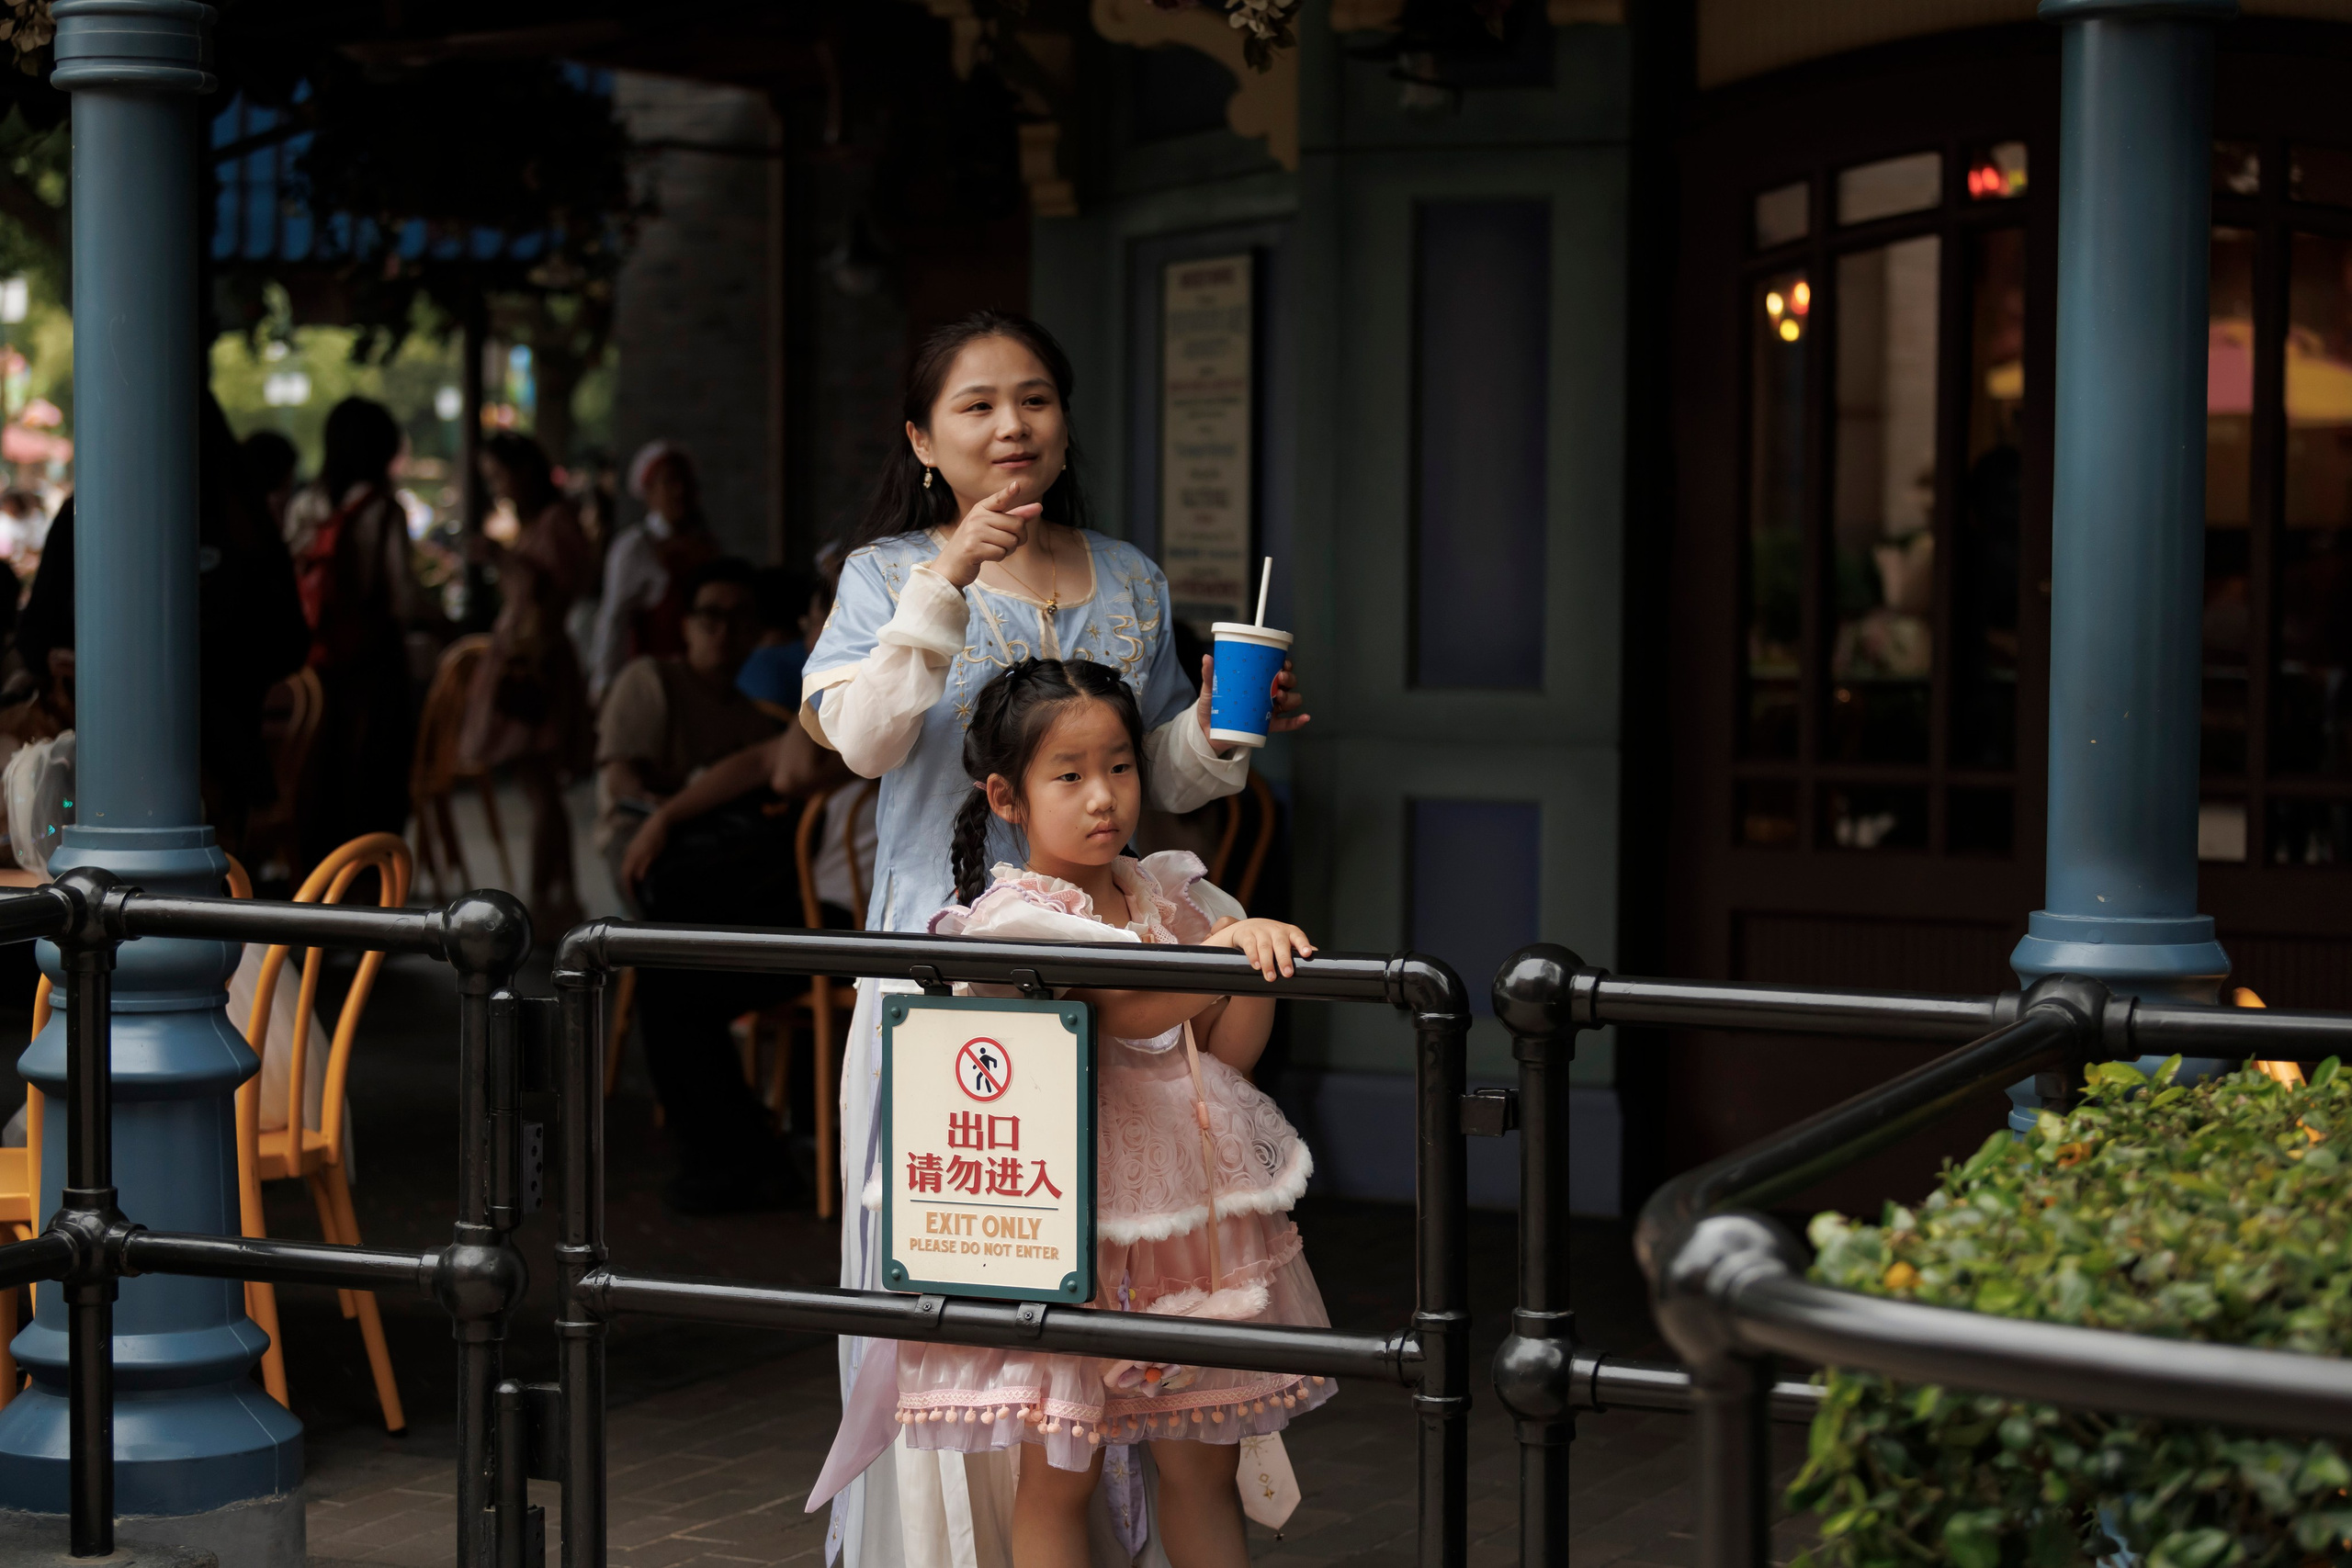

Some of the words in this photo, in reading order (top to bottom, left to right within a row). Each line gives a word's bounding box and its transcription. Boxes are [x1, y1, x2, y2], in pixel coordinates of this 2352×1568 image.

[947, 1110, 1021, 1151] 出口
[906, 1151, 1063, 1200] 请勿进入
[926, 1211, 978, 1236] EXIT
[981, 1214, 1043, 1240] ONLY
[910, 1237, 956, 1254] PLEASE
[960, 1240, 980, 1255] DO
[984, 1242, 1012, 1258] NOT
[1016, 1245, 1059, 1260] ENTER
